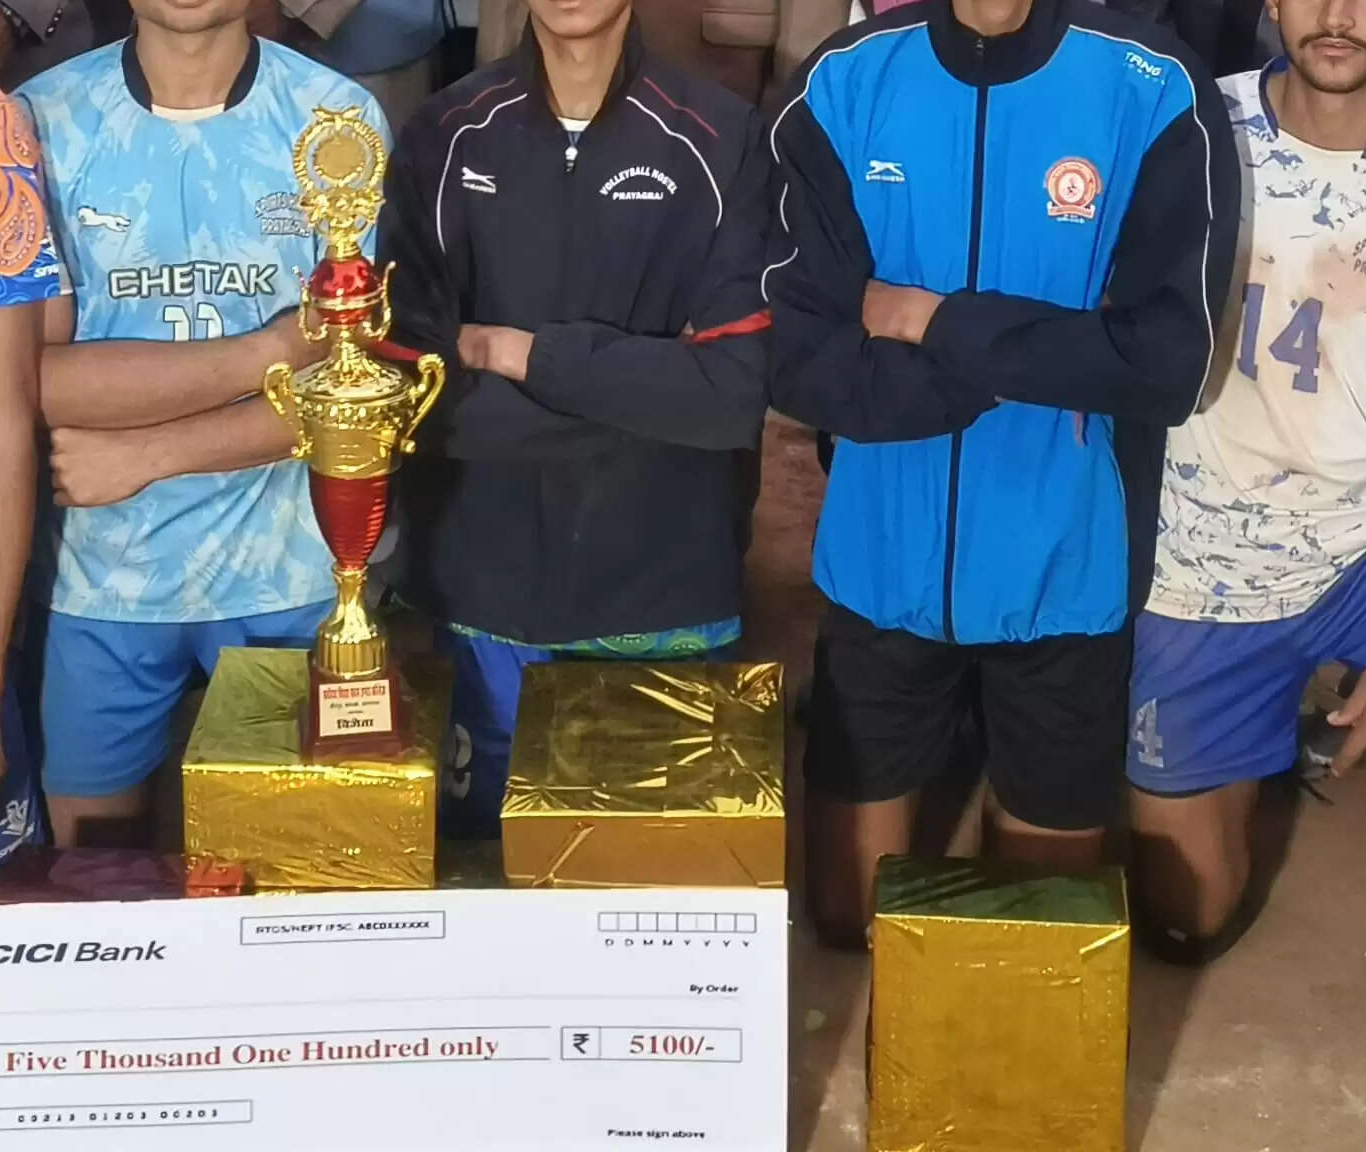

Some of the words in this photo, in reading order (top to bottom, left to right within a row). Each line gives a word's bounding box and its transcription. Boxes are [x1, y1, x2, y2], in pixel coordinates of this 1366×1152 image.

[108, 260, 278, 300] CHETAK
[1237, 282, 1323, 394] 14
[74, 939, 168, 963] Bank
[690, 984, 703, 995] By
[705, 984, 739, 993] Order
[6, 1051, 67, 1072] Five
[77, 1045, 221, 1069] Thousand
[232, 1042, 292, 1064] One
[301, 1037, 430, 1061] Hundred
[440, 1035, 500, 1060] only
[629, 1034, 715, 1056] 5100/-
[646, 1129, 670, 1139] sign
